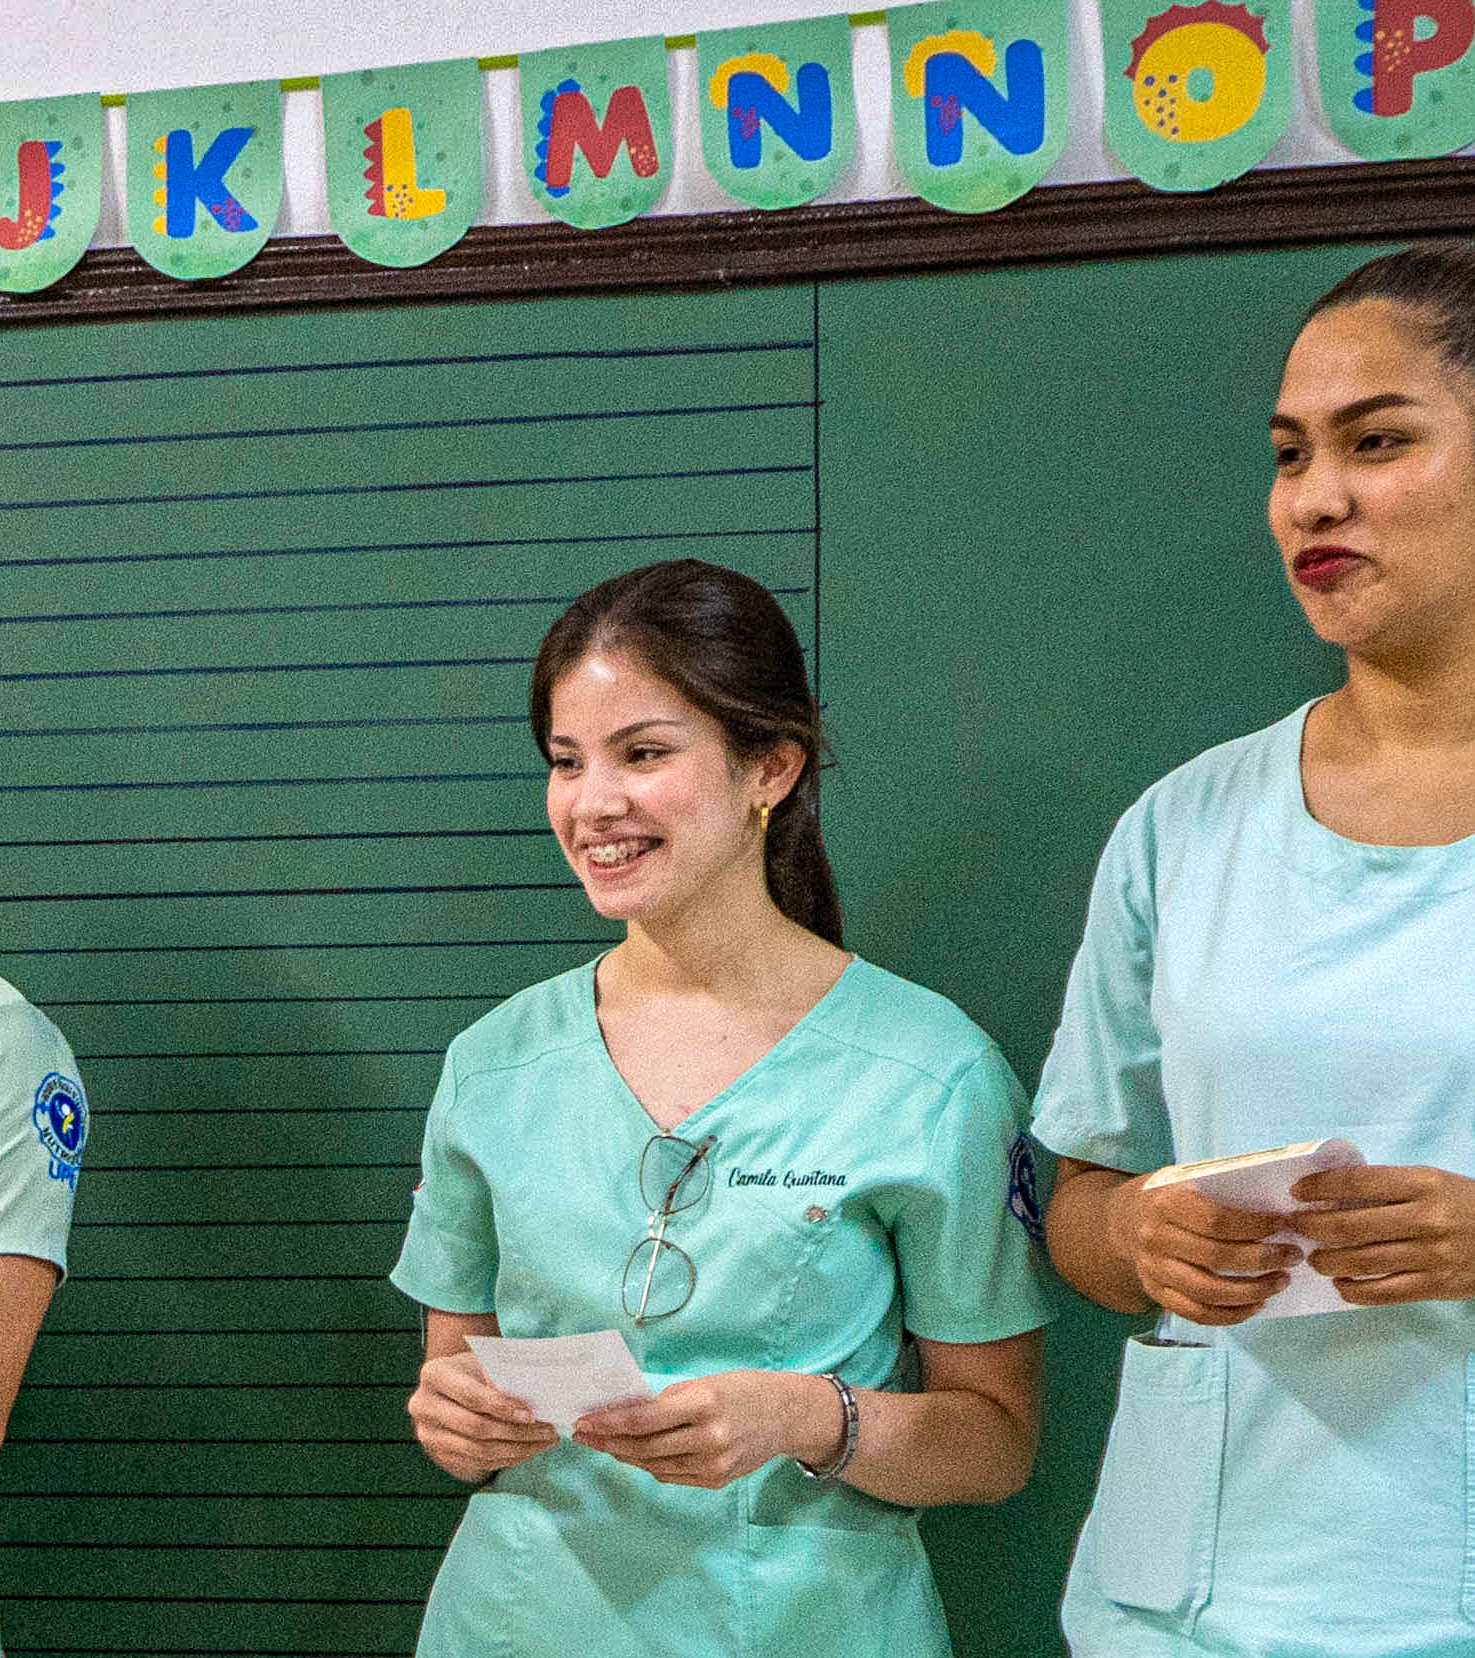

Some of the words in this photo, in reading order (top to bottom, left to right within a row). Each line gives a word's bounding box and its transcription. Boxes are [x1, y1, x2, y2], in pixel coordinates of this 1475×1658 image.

[165, 126, 258, 240] K
[379, 107, 447, 221] L
[544, 86, 660, 190] M
[726, 61, 834, 170] N
[1132, 22, 1268, 143] O
[727, 1166, 779, 1189] Camila
